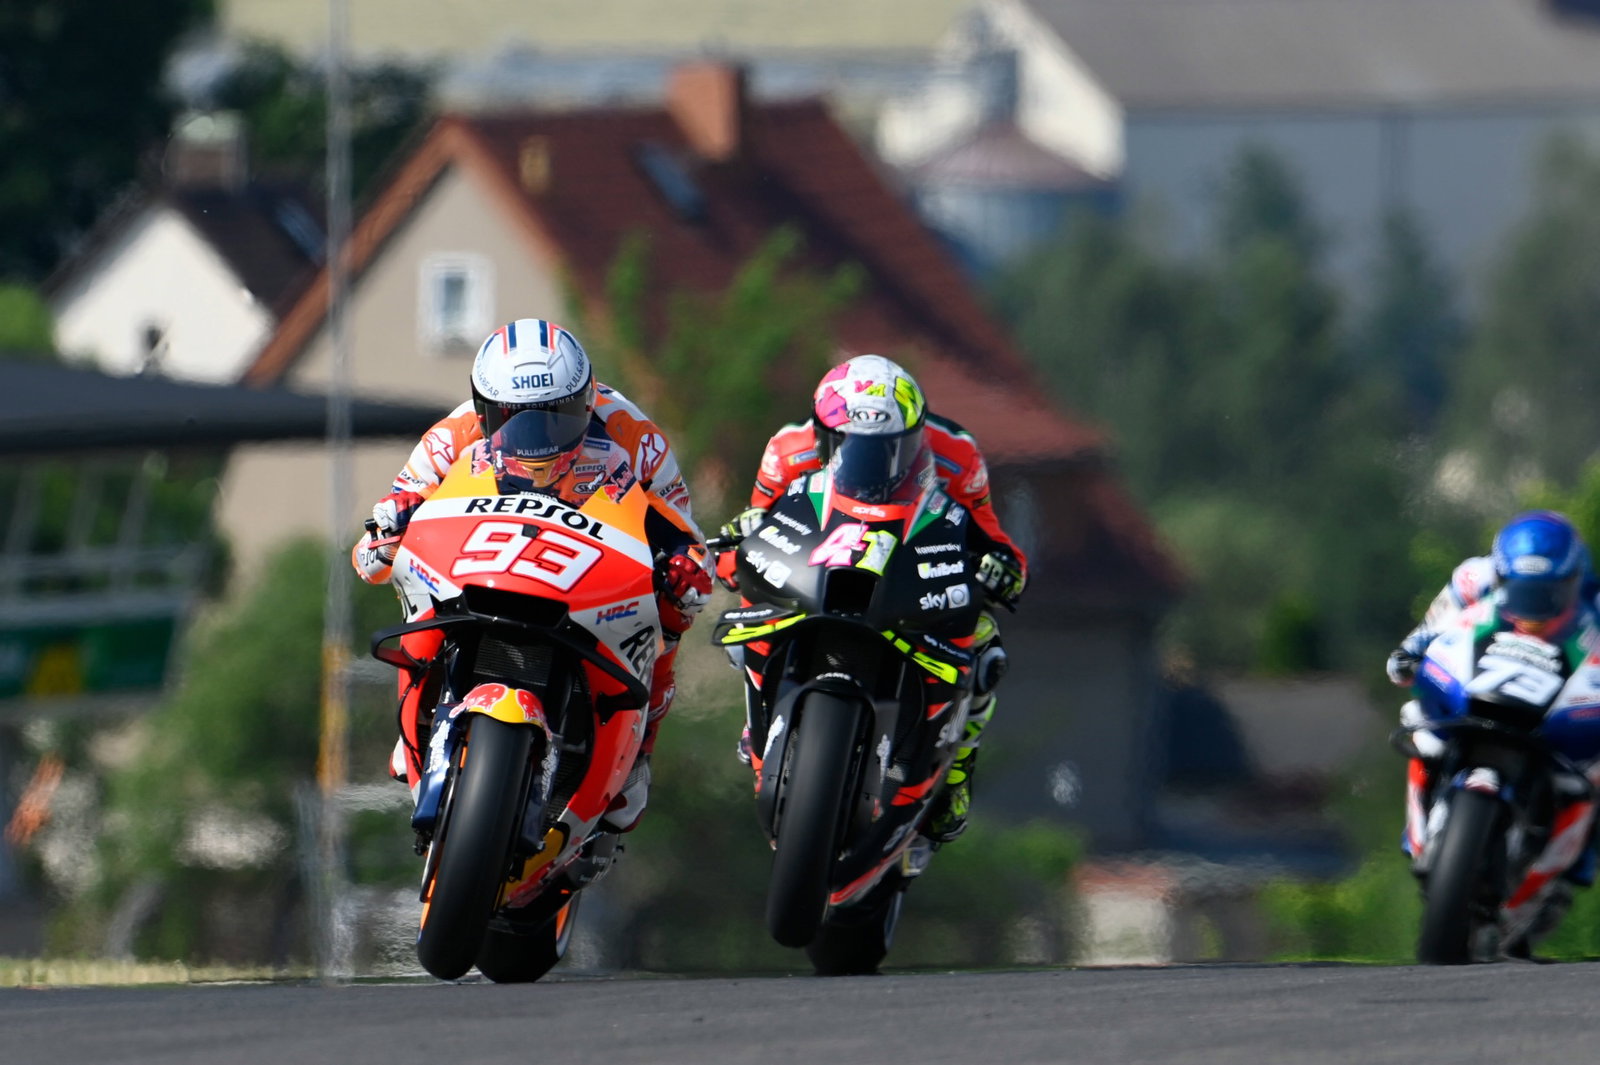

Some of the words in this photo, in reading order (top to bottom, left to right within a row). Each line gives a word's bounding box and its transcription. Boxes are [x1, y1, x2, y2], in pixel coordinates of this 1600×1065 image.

[512, 373, 554, 389] SHOEI
[517, 446, 559, 456] PULL&BEAR
[575, 464, 607, 473] REPSOL
[465, 498, 604, 540] REPSOL
[450, 520, 604, 594] 93
[808, 523, 898, 577] 41
[915, 543, 962, 556] kaspersky
[746, 550, 771, 574] sky
[917, 560, 964, 580] Unibet
[409, 558, 440, 594] HRC
[919, 592, 946, 611] sky
[596, 601, 639, 625] HRC
